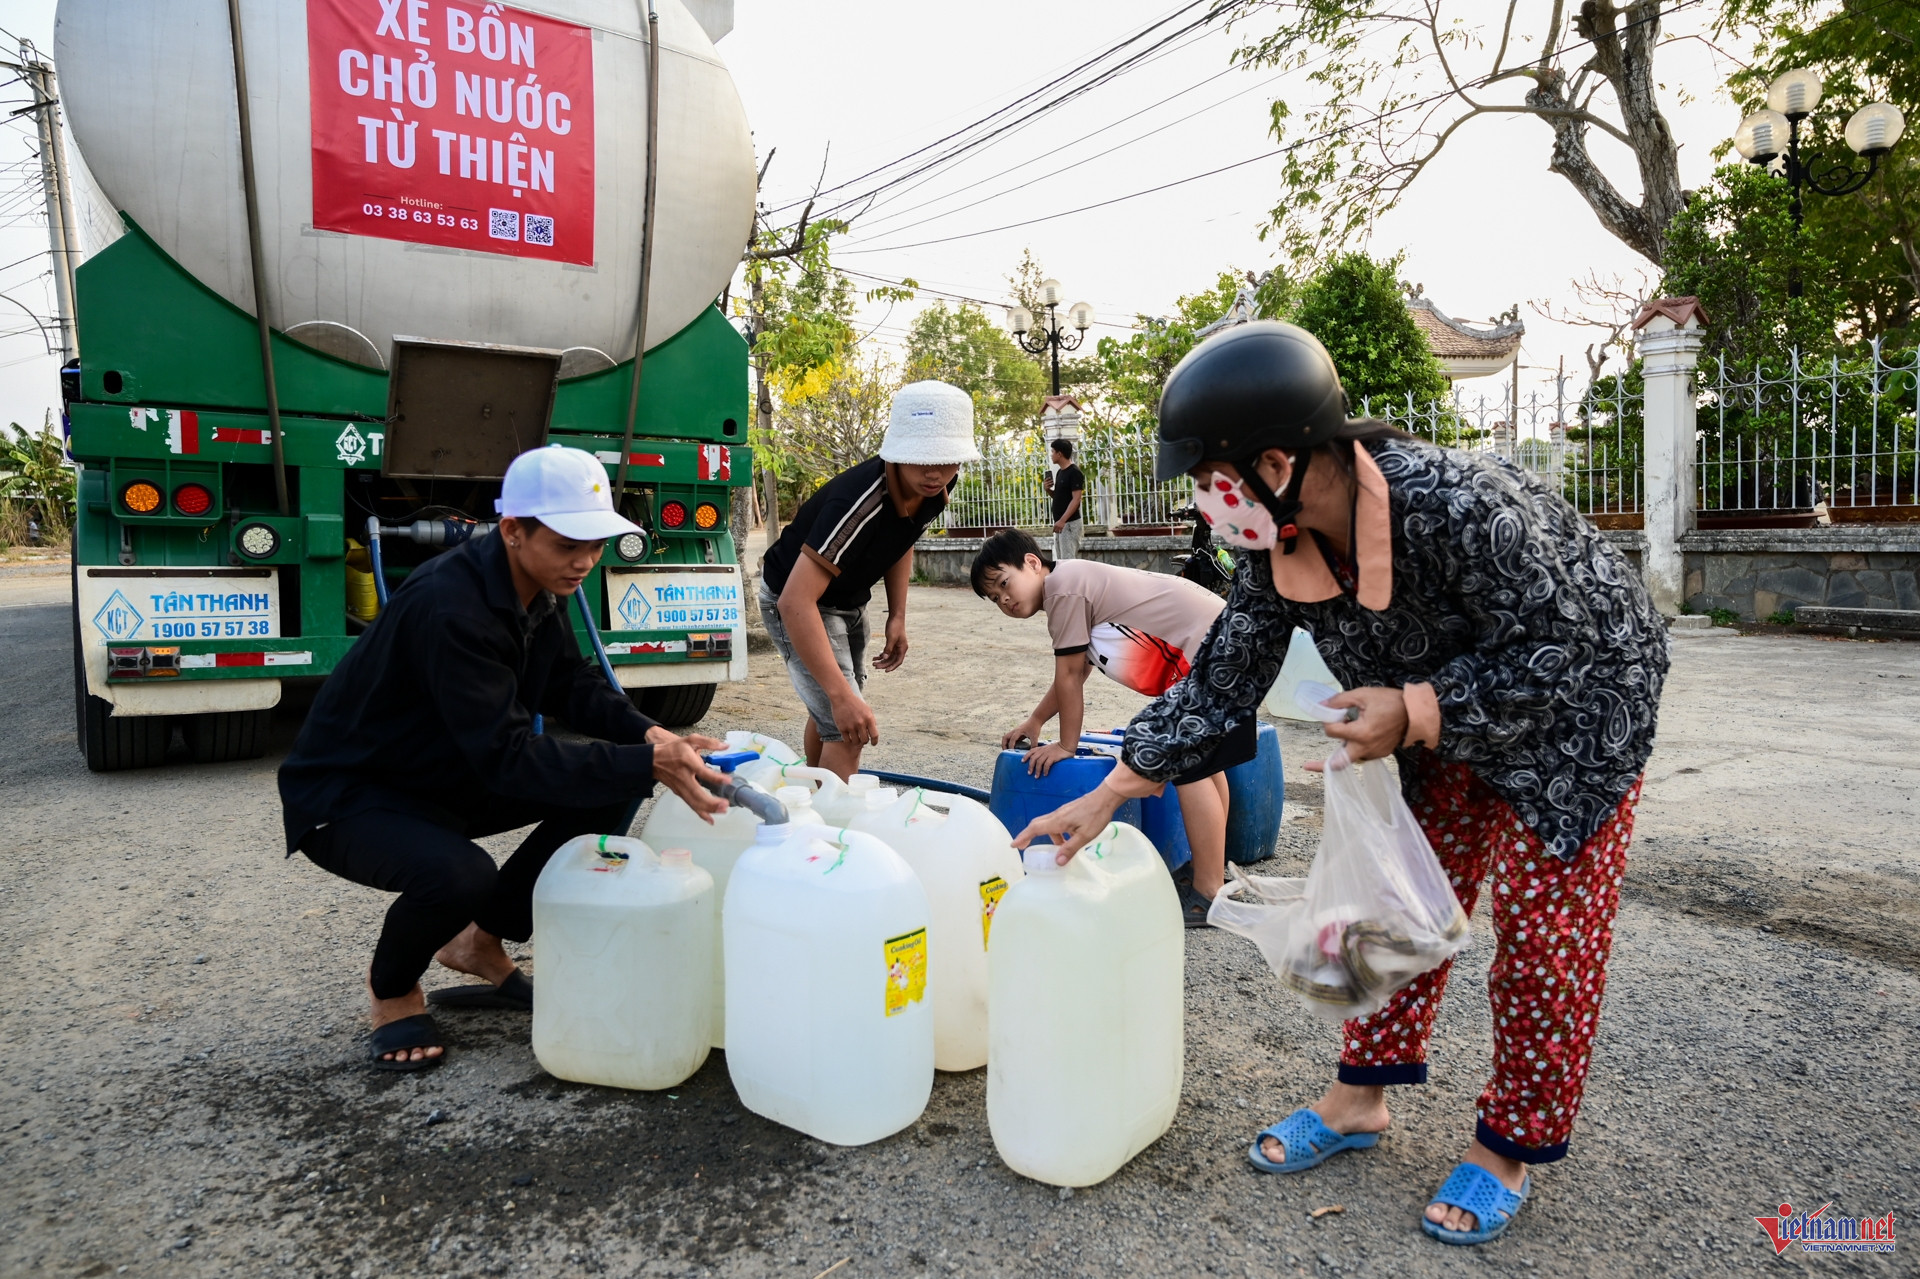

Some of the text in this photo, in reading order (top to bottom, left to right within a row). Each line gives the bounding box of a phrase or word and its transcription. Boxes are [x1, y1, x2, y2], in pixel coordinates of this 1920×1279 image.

[375, 0, 536, 69] XE BỒN
[338, 49, 572, 136] CHỞ NƯỚC
[357, 108, 555, 198] TỪ THIỆN
[400, 195, 443, 211] Hotline:
[363, 203, 479, 231] 03 38 63 53 63
[150, 590, 268, 614] TÂN THANH
[655, 584, 737, 602] TÂN THANH
[107, 607, 129, 635] KCT
[657, 608, 738, 622] 1900 57 57 38
[152, 620, 270, 638] 1900 57 57 38
